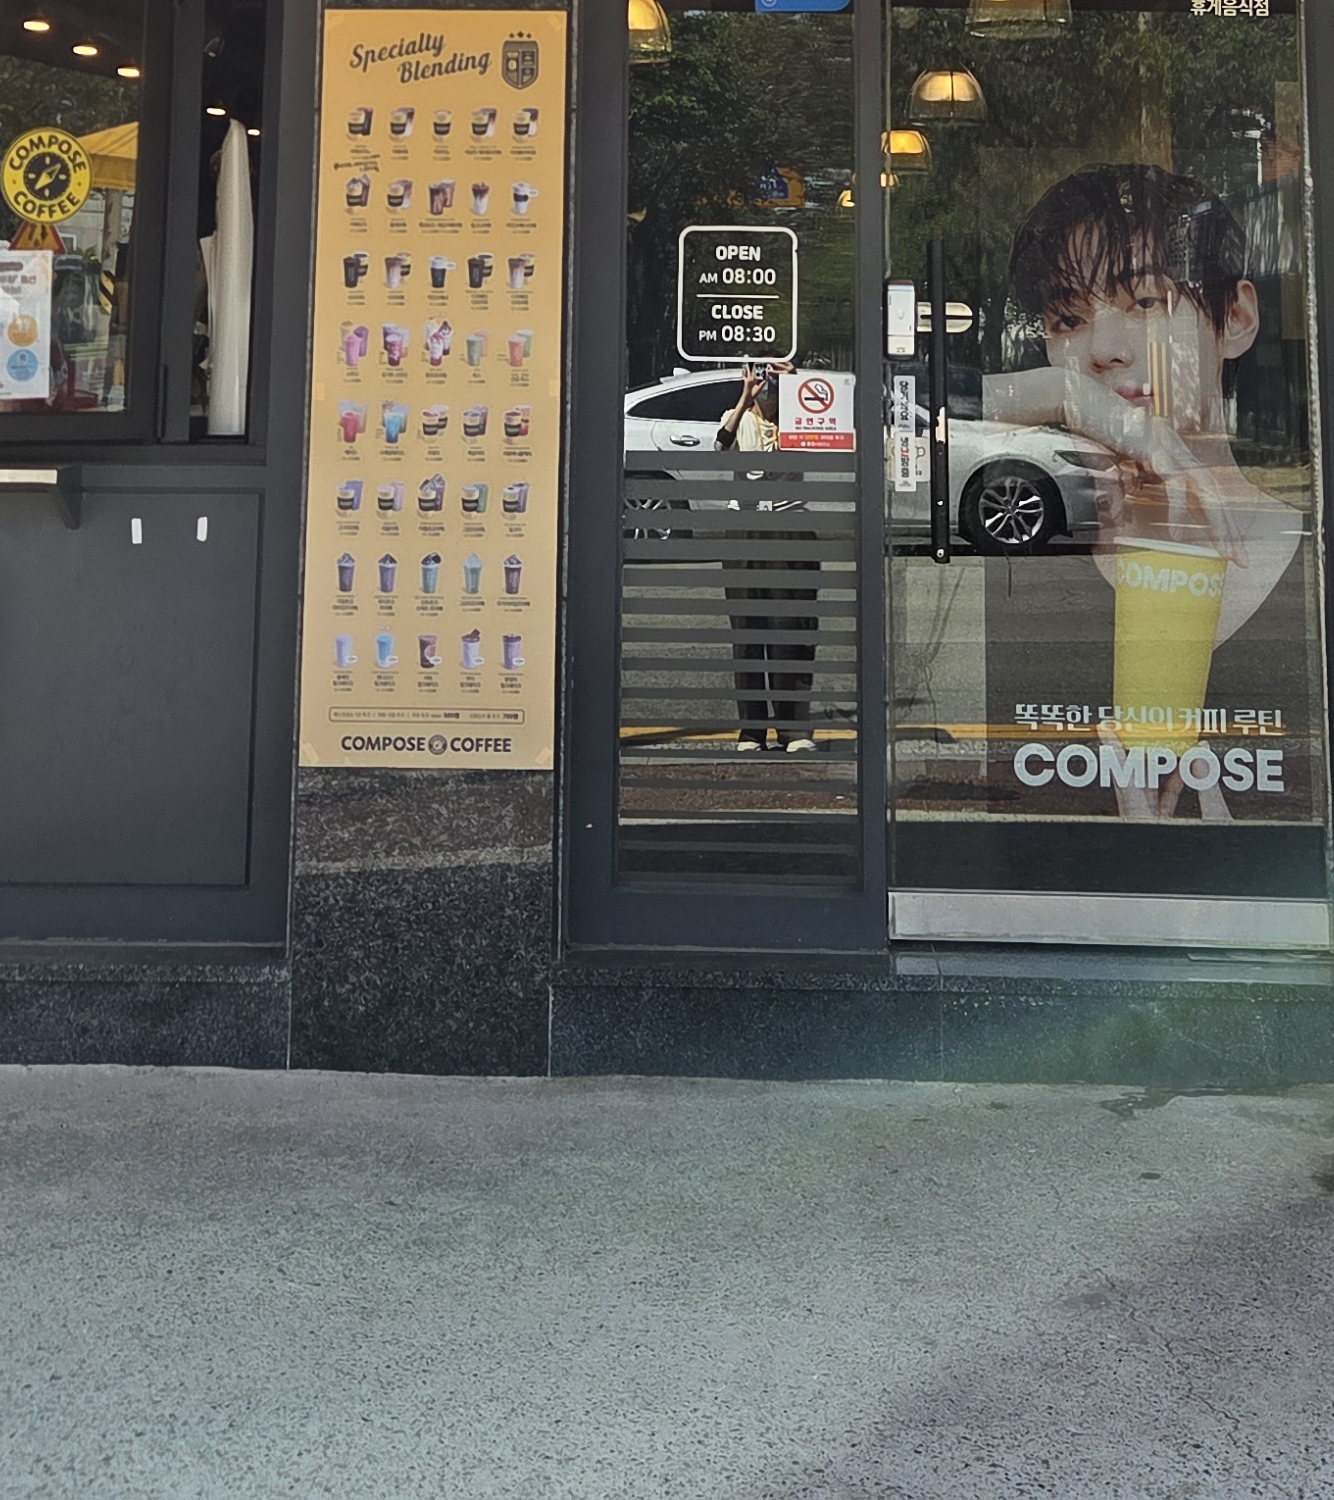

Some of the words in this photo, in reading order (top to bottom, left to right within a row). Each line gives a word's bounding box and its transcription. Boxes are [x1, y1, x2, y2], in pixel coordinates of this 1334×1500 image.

[397, 52, 491, 84] Blending
[9, 134, 87, 173] COMPOSE
[13, 190, 81, 220] COFFEE
[715, 246, 761, 261] OPEN
[699, 273, 718, 284] AM
[722, 268, 776, 285] 08:00
[711, 305, 764, 320] CLOSE
[698, 330, 717, 341] PM
[721, 325, 776, 343] 08:30
[1014, 703, 1092, 732] 똑똑한
[1098, 704, 1172, 733] 당신의
[1178, 707, 1227, 734] 커피
[1232, 708, 1287, 736] 루틴
[341, 736, 426, 751] COMPOSE
[450, 737, 512, 753] COFFEE
[1013, 742, 1285, 792] COMPOSE
